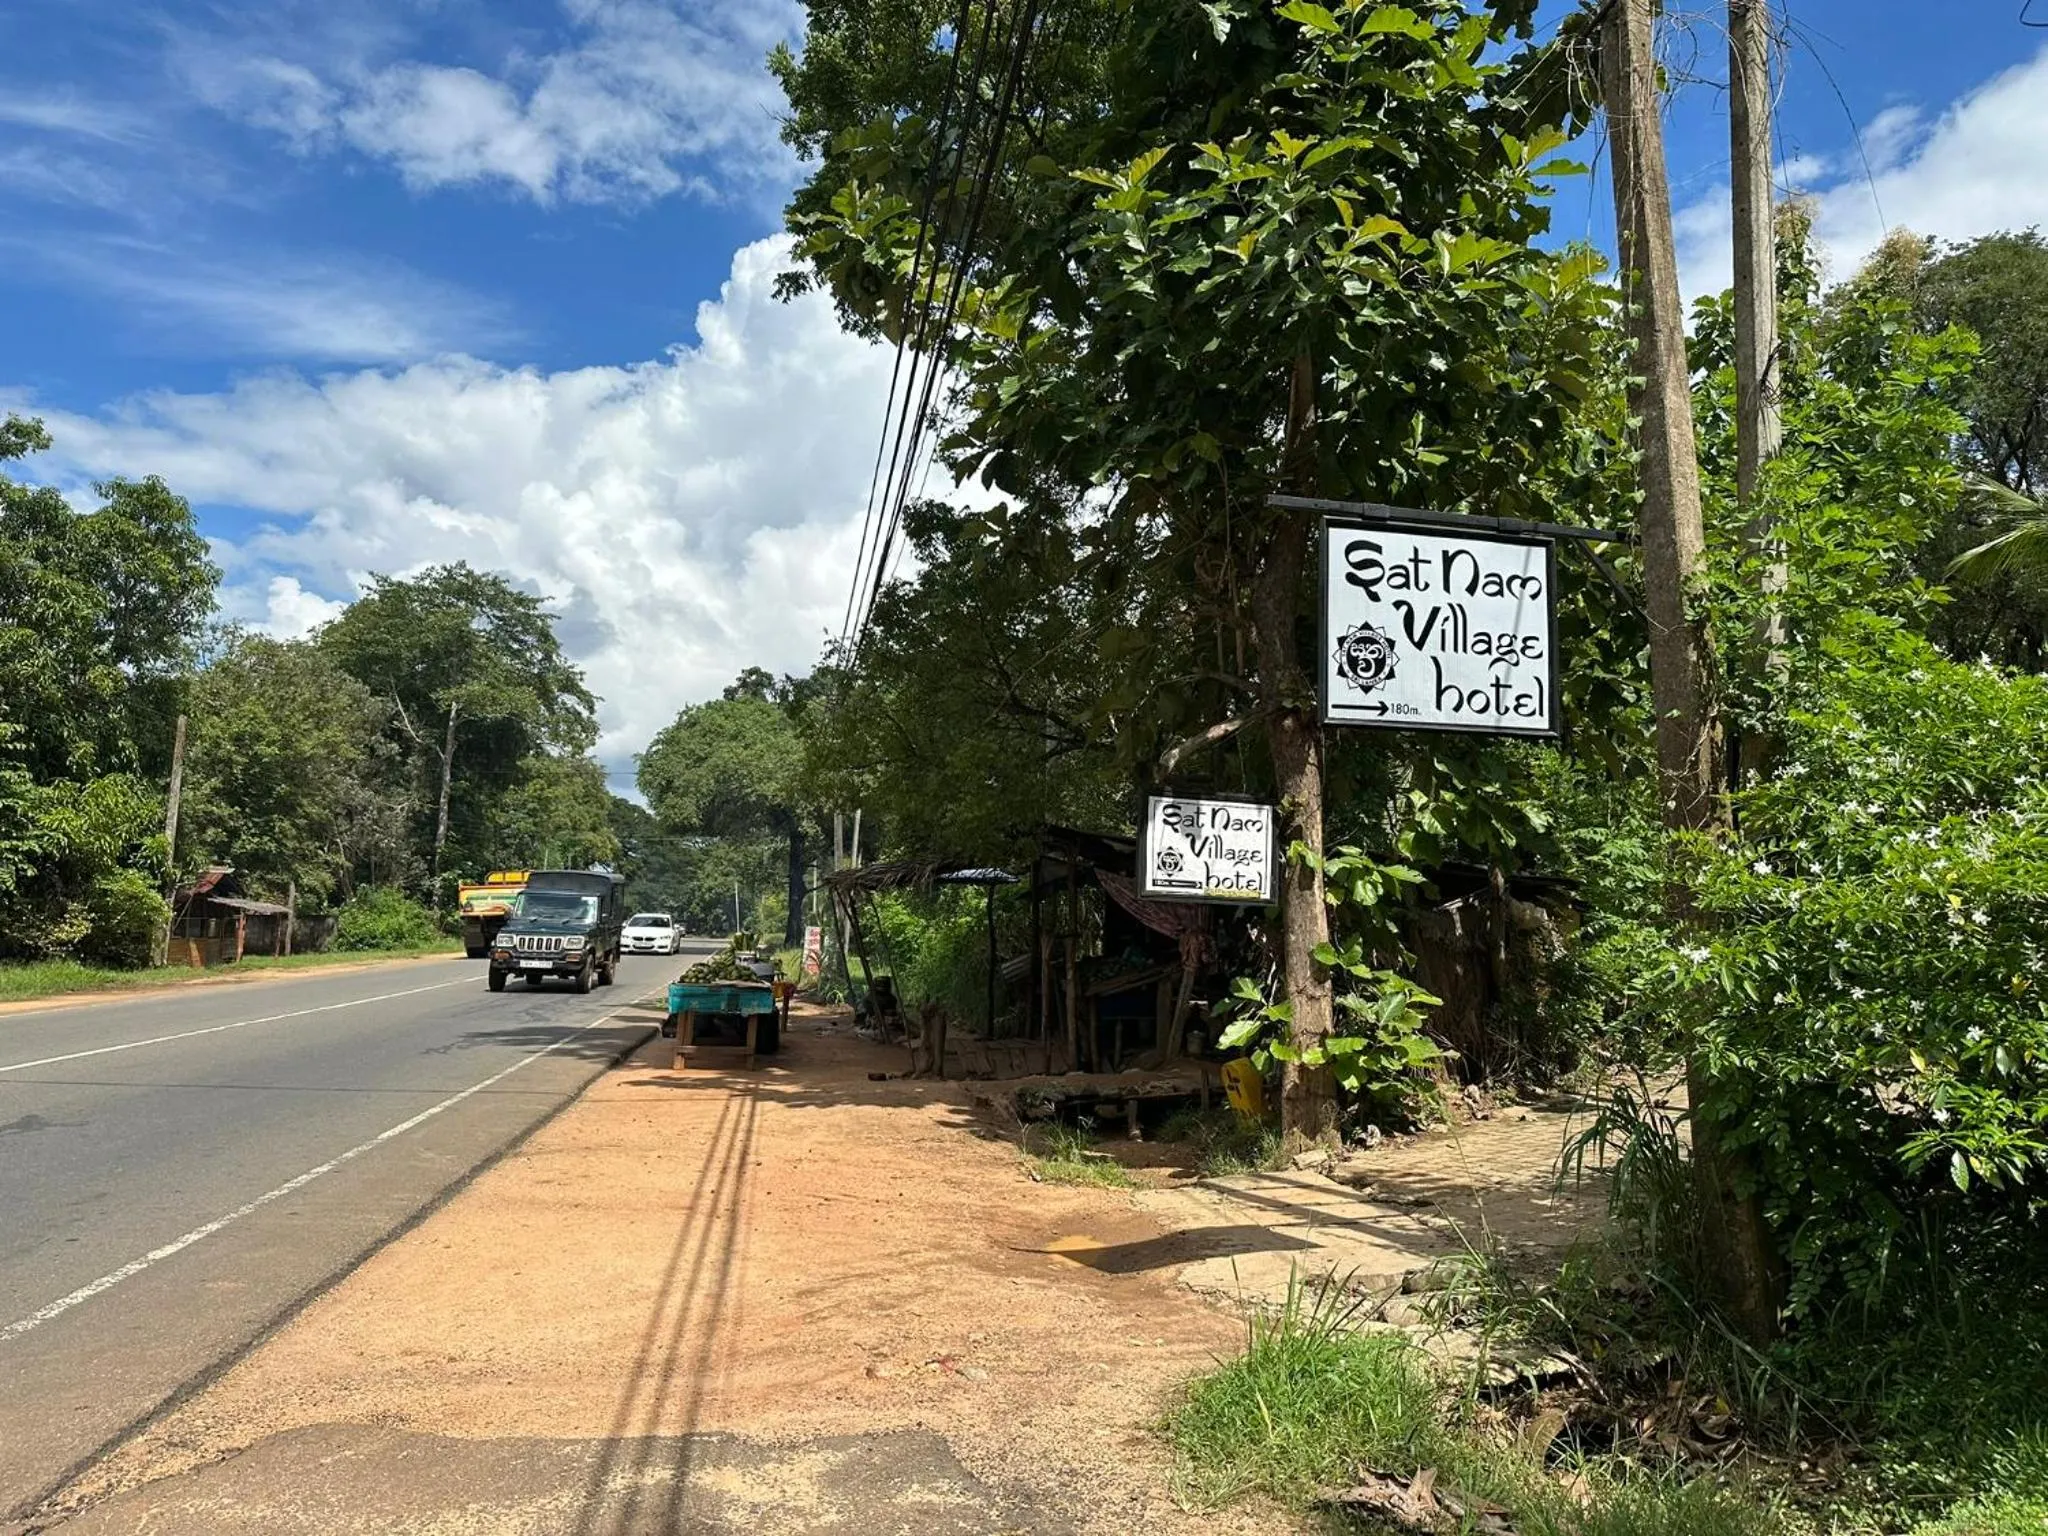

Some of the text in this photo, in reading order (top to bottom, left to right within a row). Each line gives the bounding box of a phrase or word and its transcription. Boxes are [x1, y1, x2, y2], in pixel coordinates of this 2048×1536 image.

[1344, 539, 1543, 602] Sat Nam
[1391, 600, 1544, 670] Village
[1430, 655, 1544, 718] hotel
[1162, 803, 1263, 834] Sat Nam
[1185, 833, 1263, 867] Village
[1203, 861, 1263, 891] hotel
